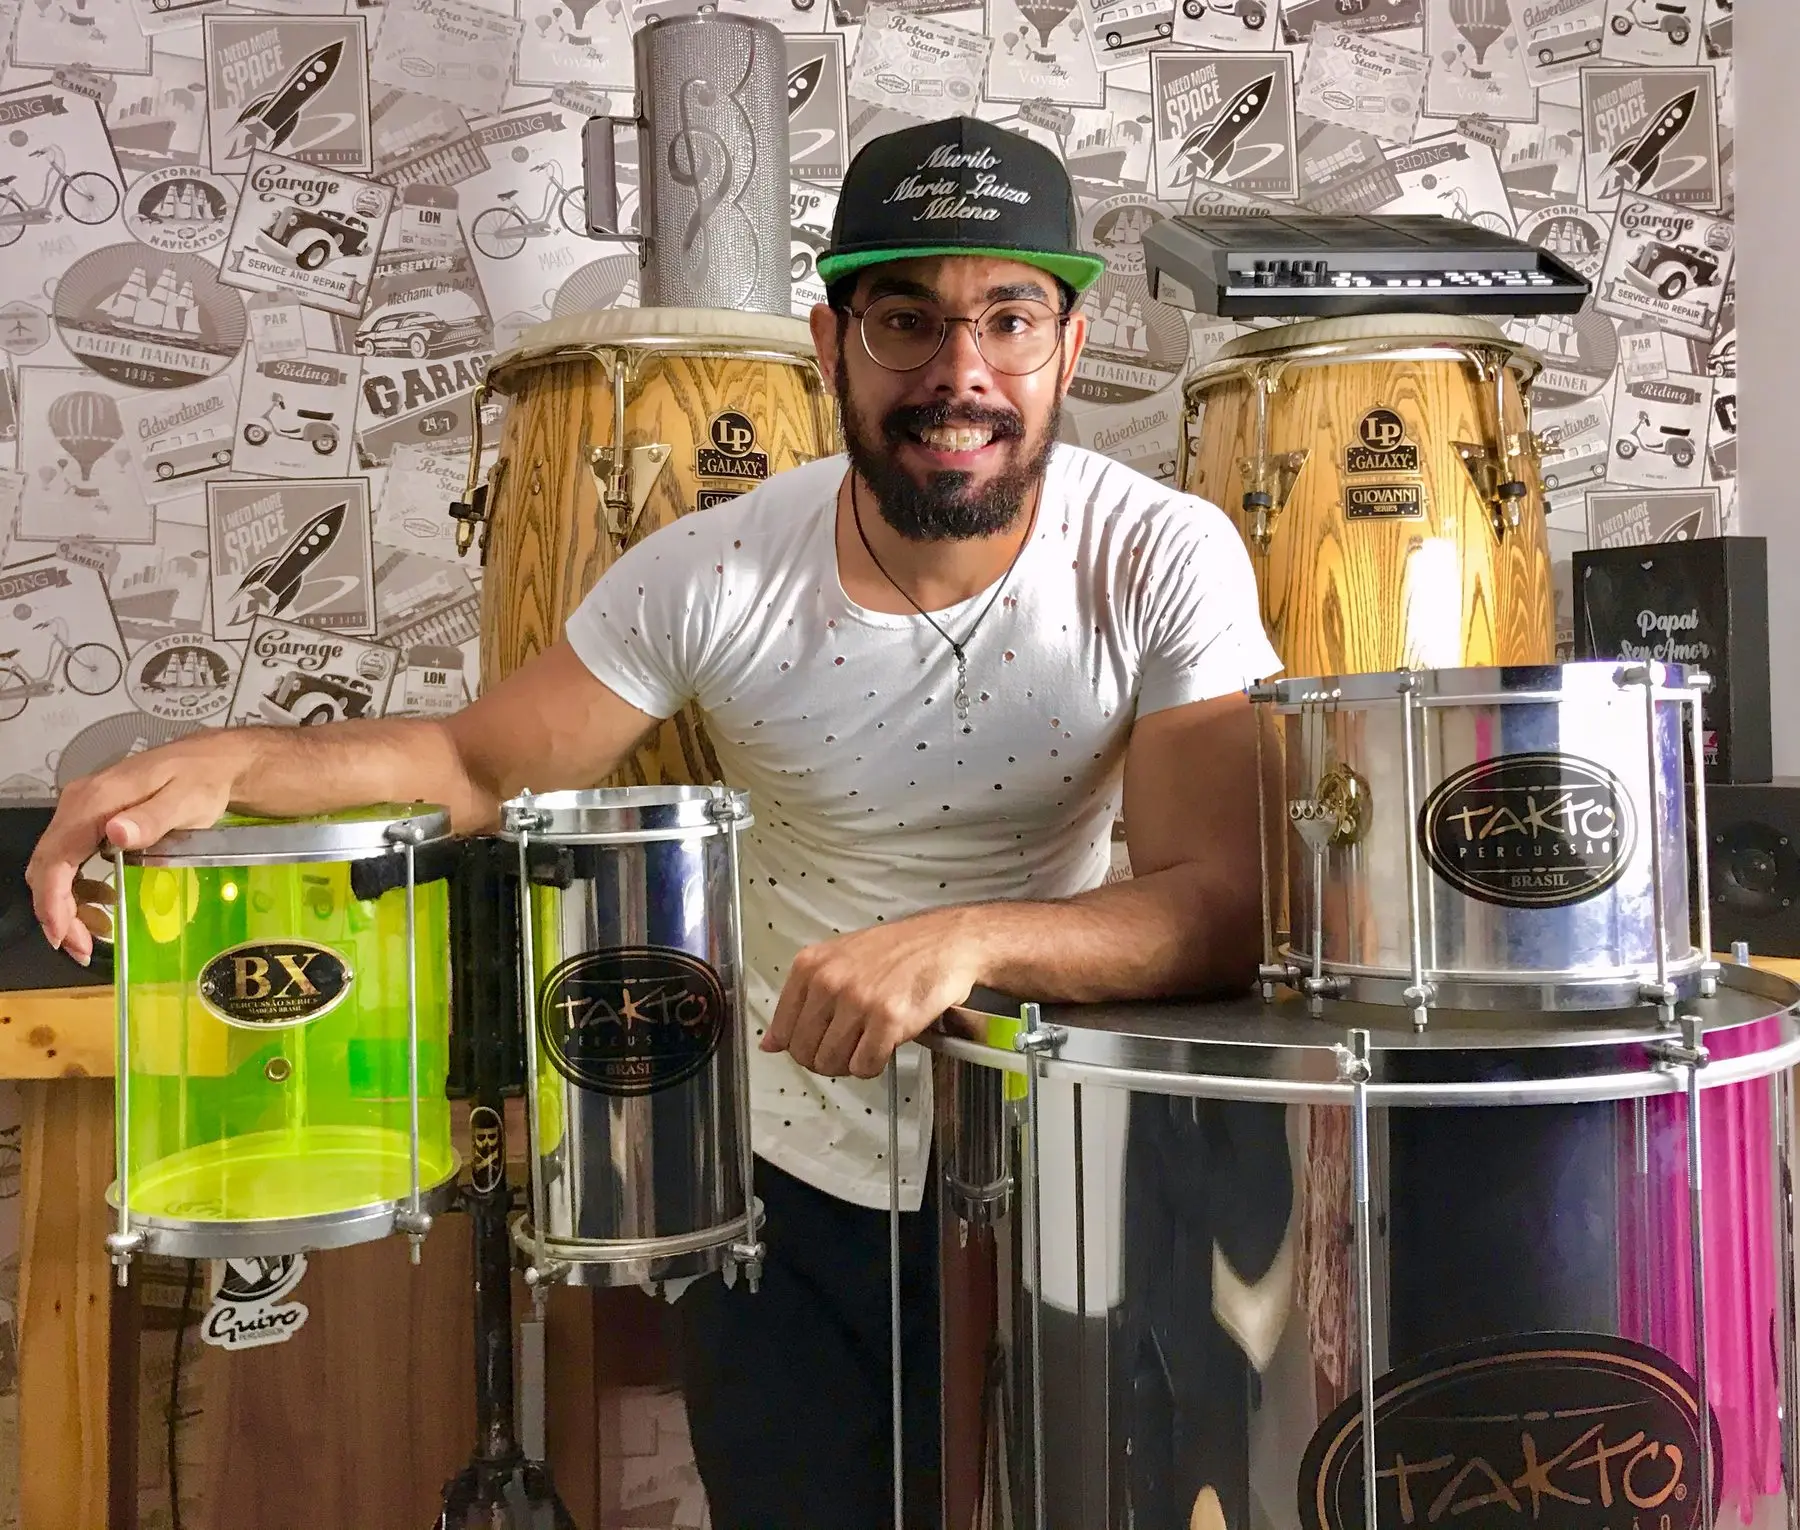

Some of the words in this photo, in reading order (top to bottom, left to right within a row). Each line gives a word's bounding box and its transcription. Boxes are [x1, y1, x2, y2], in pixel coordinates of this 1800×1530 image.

[433, 18, 479, 41] Stamp
[888, 15, 935, 40] Retro
[223, 40, 249, 63] NEED
[250, 27, 281, 52] MORE
[907, 35, 950, 59] Stamp
[1334, 34, 1379, 58] Retro
[222, 45, 285, 108] SPACE
[1351, 53, 1393, 76] Stamp
[61, 79, 102, 100] CANADA
[1168, 74, 1191, 97] NEED
[1191, 63, 1218, 86] MORE
[1618, 78, 1644, 100] MORE
[560, 96, 597, 116] CANADA
[1166, 80, 1222, 139] SPACE
[481, 116, 545, 144] RIDING
[1026, 113, 1062, 132] CANADA
[1595, 94, 1648, 152] SPACE
[1463, 129, 1497, 146] CANADA
[917, 144, 1001, 170] Murilo
[1394, 146, 1450, 172] RIDING
[152, 168, 201, 182] STORM
[251, 164, 340, 207] Garage
[883, 175, 959, 204] Maria
[966, 172, 1031, 205] Luiza
[913, 197, 1001, 221] Milena
[1104, 195, 1148, 209] STORM
[1537, 206, 1579, 221] STORM
[419, 210, 441, 225] LON
[1620, 203, 1694, 242] Garage
[248, 259, 287, 277] SERVICE
[290, 271, 310, 283] AND
[313, 276, 346, 292] REPAIR
[388, 284, 433, 306] Mechanic
[436, 281, 450, 295] On
[453, 277, 476, 293] Duty
[1618, 288, 1650, 305] SERVICE
[1653, 299, 1669, 311] AND
[1672, 305, 1700, 319] REPAIR
[264, 313, 287, 326] PAR
[1204, 332, 1225, 345] PAR
[1632, 338, 1651, 350] PAR
[141, 345, 210, 371] MARINER
[274, 361, 331, 384] Riding
[1096, 365, 1157, 387] MARINER
[1081, 383, 1109, 398] 1995
[1641, 384, 1688, 403] Riding
[138, 396, 224, 440] Adventurer
[1093, 410, 1168, 450] Adventurer
[717, 420, 751, 451] LP
[1366, 417, 1400, 446] LP
[417, 457, 465, 480] Retro
[707, 459, 759, 476] GALAXY
[1356, 454, 1409, 469] GALAXY
[1352, 489, 1417, 503] GIOVANNI
[227, 504, 252, 528] NEED
[253, 492, 283, 517] MORE
[1602, 512, 1623, 532] NEED
[1623, 501, 1649, 522] MORE
[224, 510, 288, 574] SPACE
[65, 551, 105, 570] CANADA
[1637, 608, 1699, 638] Papai
[154, 633, 204, 650] STORM
[255, 629, 343, 671] Garage
[1653, 637, 1710, 663] Amor
[424, 671, 446, 685] LON
[1459, 841, 1610, 859] PERCUSSÃO
[1511, 873, 1569, 888] BRASIL
[231, 952, 321, 1000] BX
[209, 1307, 300, 1342] Guiro
